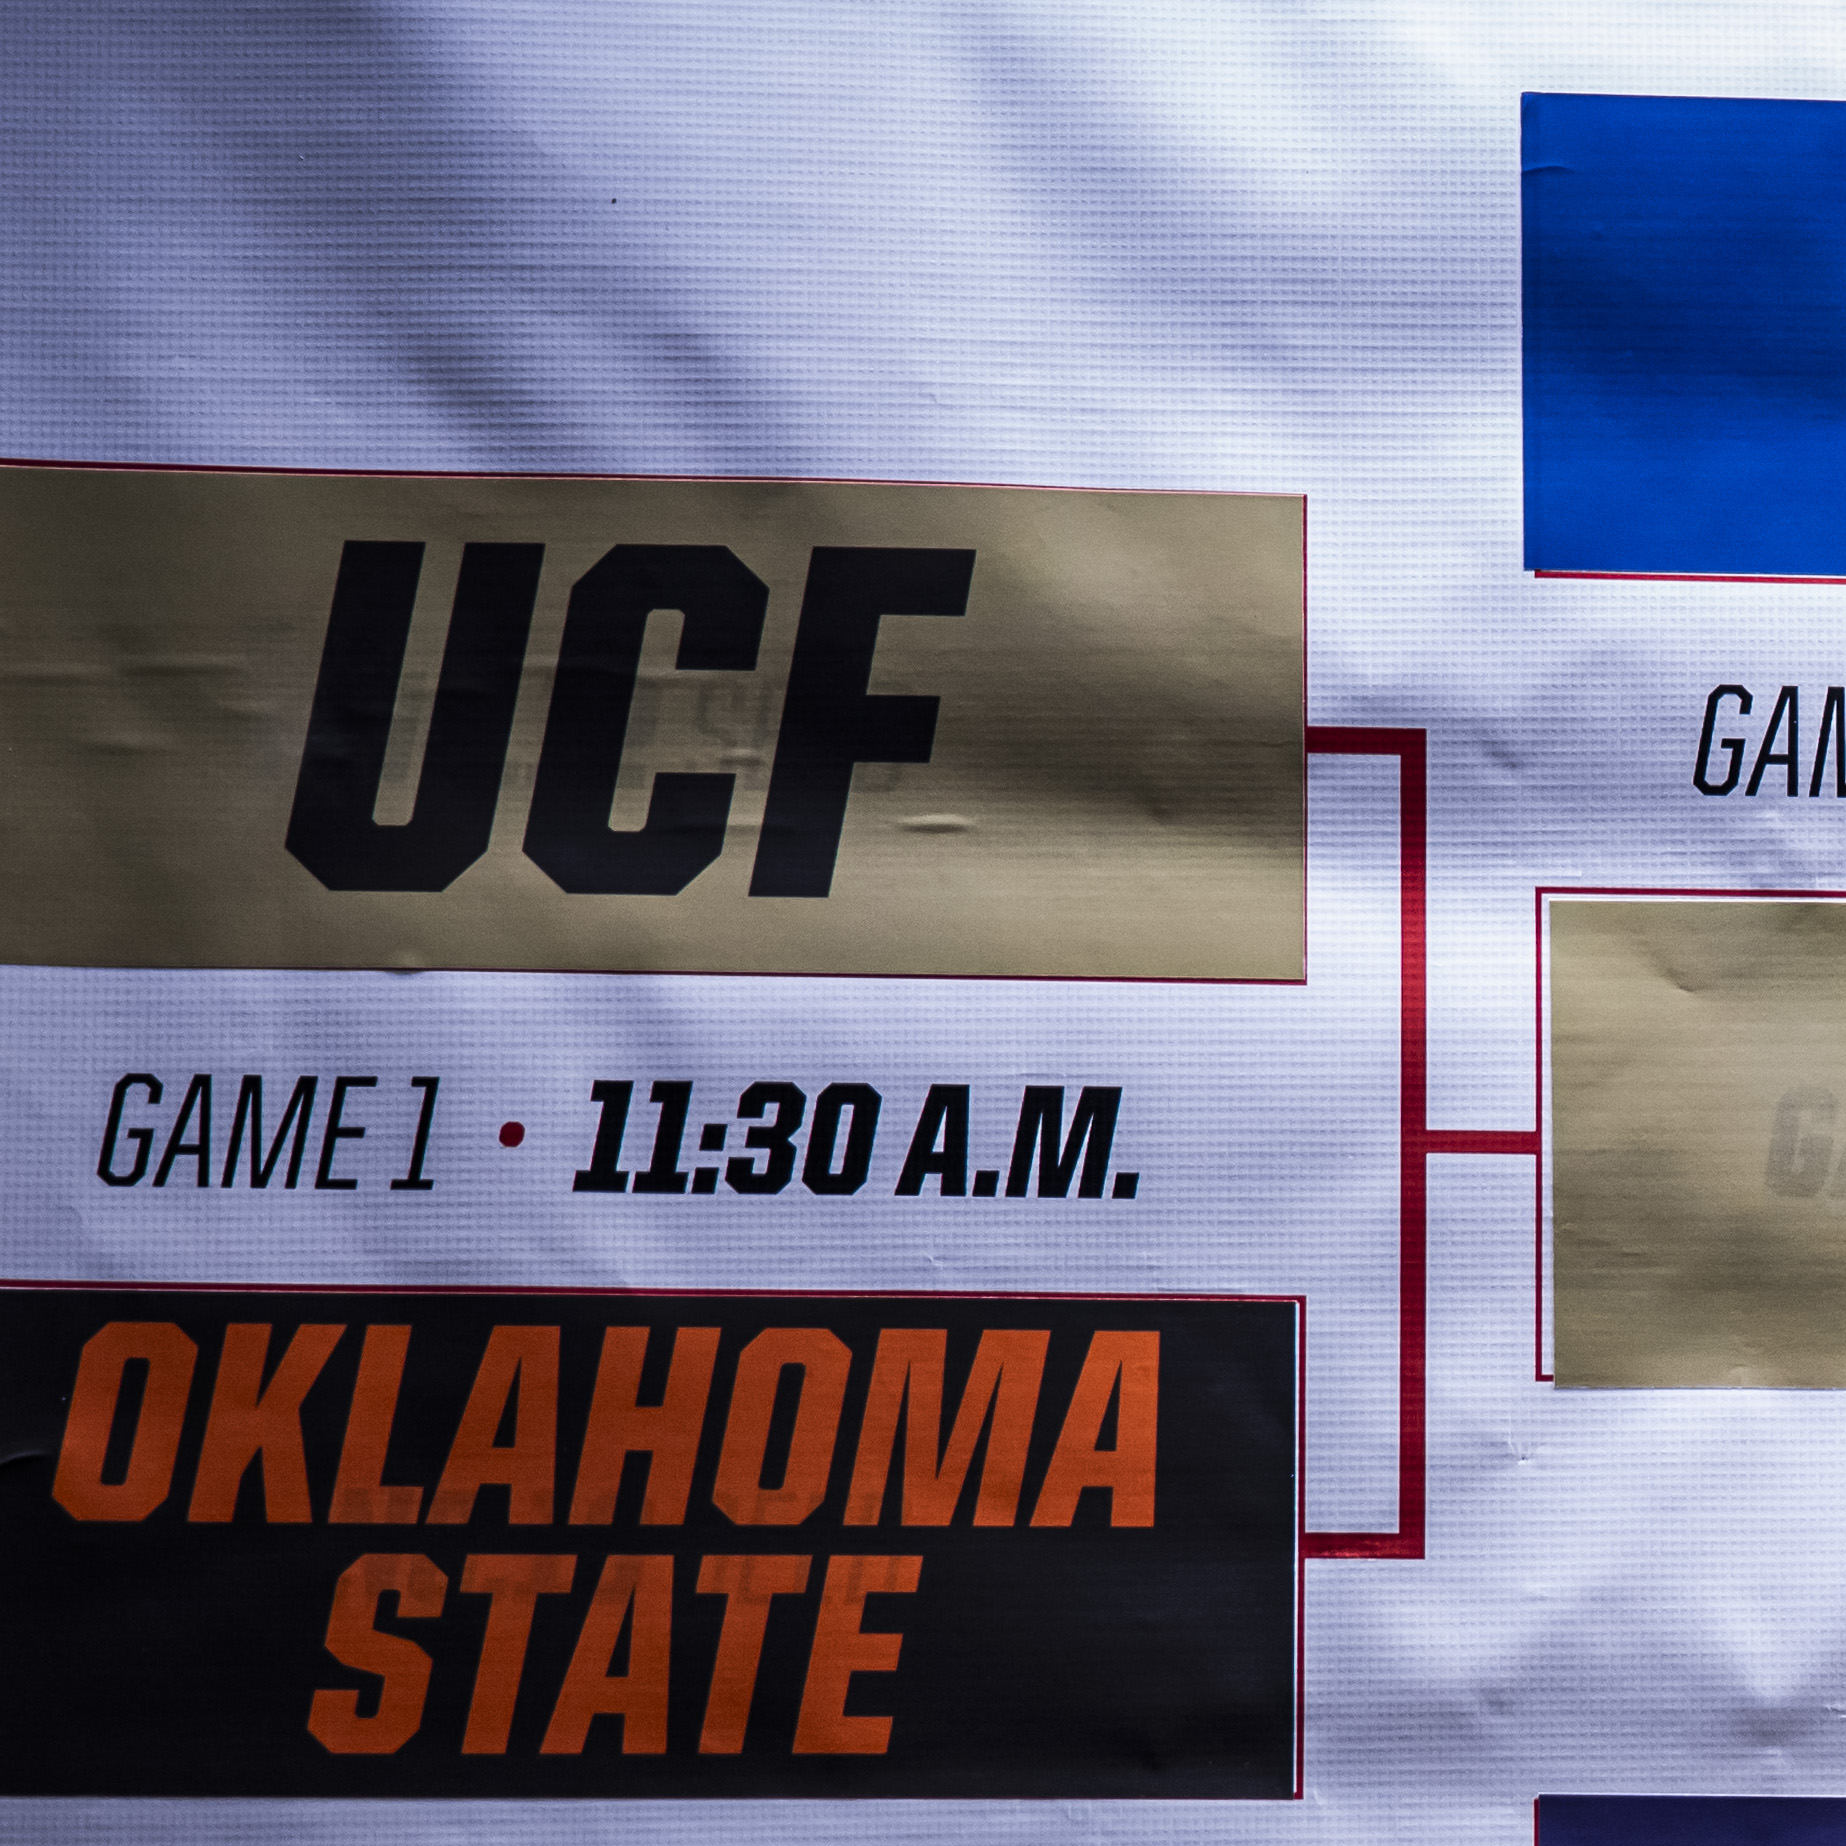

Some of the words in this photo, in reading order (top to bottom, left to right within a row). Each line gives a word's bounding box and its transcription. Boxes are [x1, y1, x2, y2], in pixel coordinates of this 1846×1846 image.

[284, 540, 978, 898] UCF
[96, 1073, 377, 1189] GAME
[390, 1076, 441, 1190] 1
[572, 1080, 882, 1195] 11:30
[894, 1084, 1140, 1200] A.M.
[52, 1321, 1160, 1528] OKLAHOMA
[306, 1553, 924, 1755] STATE
